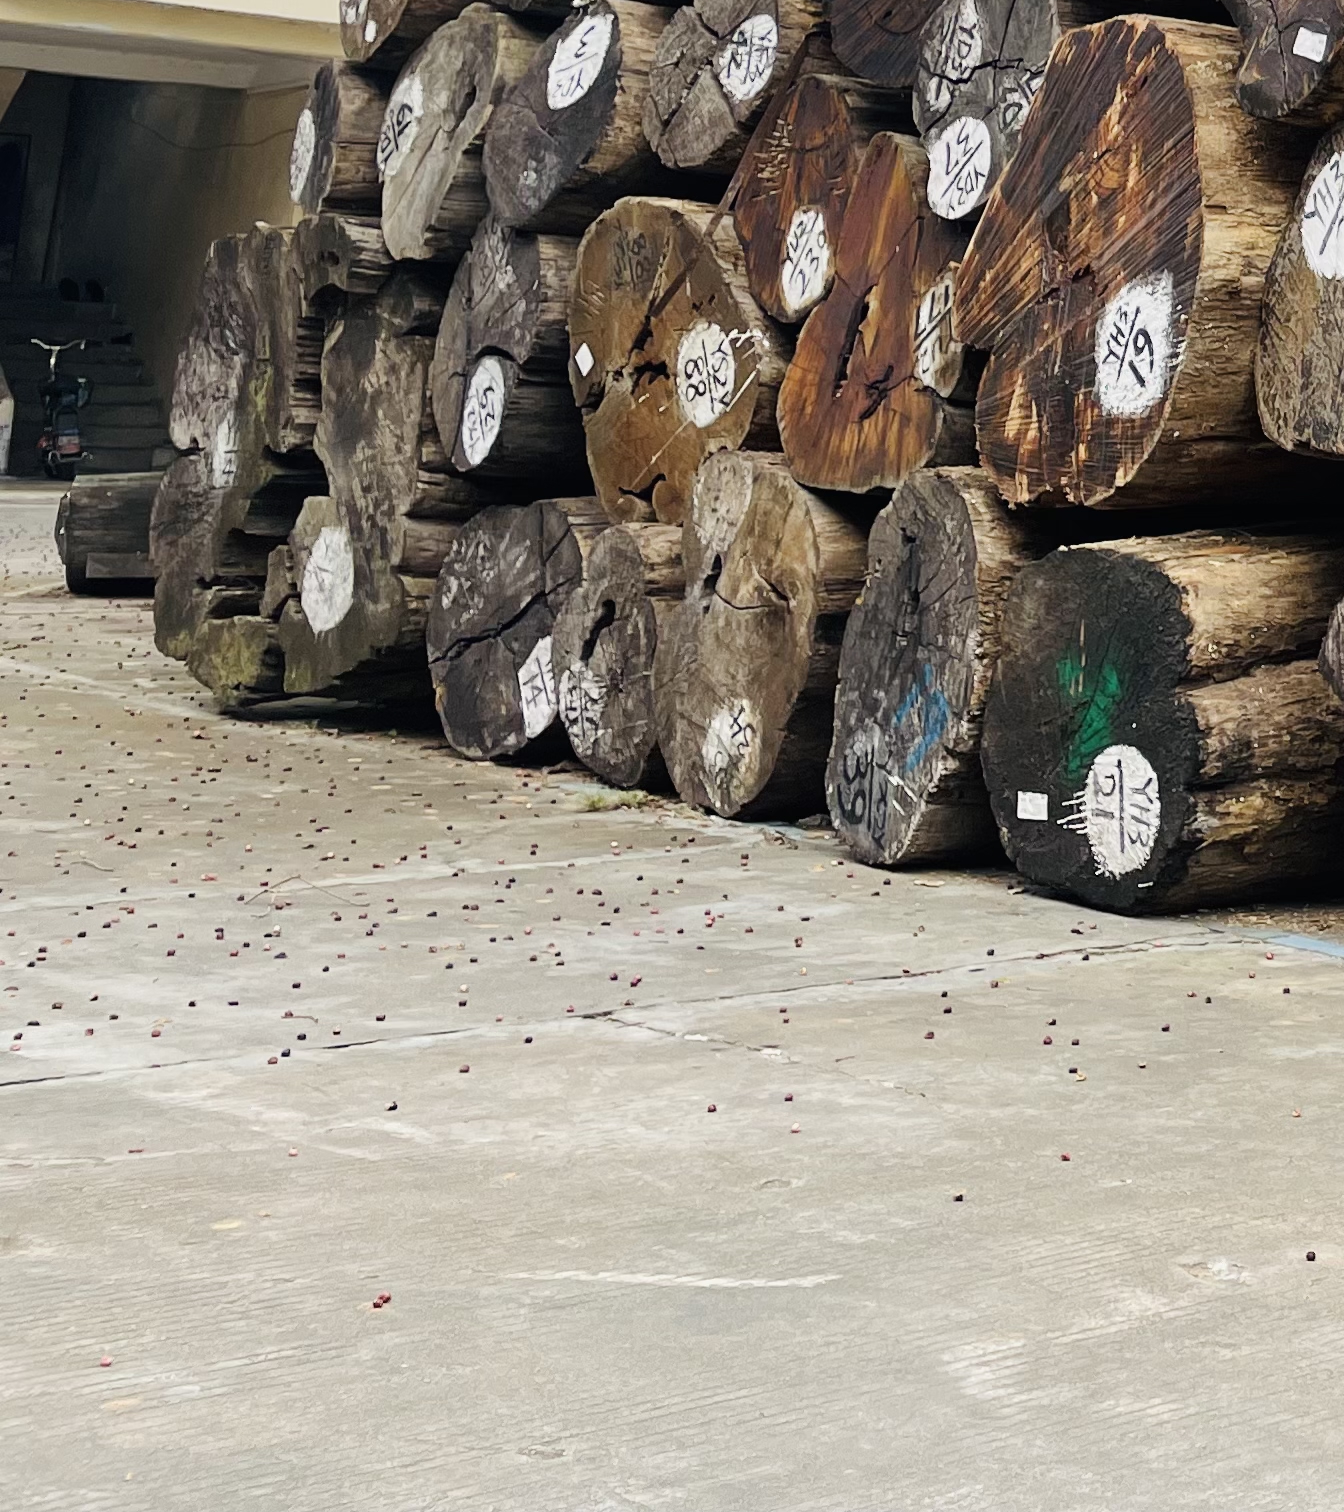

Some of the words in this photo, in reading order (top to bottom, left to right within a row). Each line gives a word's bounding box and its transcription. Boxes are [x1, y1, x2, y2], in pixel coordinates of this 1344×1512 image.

[1103, 304, 1131, 366] YH3
[1127, 327, 1156, 388] 19
[1124, 779, 1159, 850] YH3
